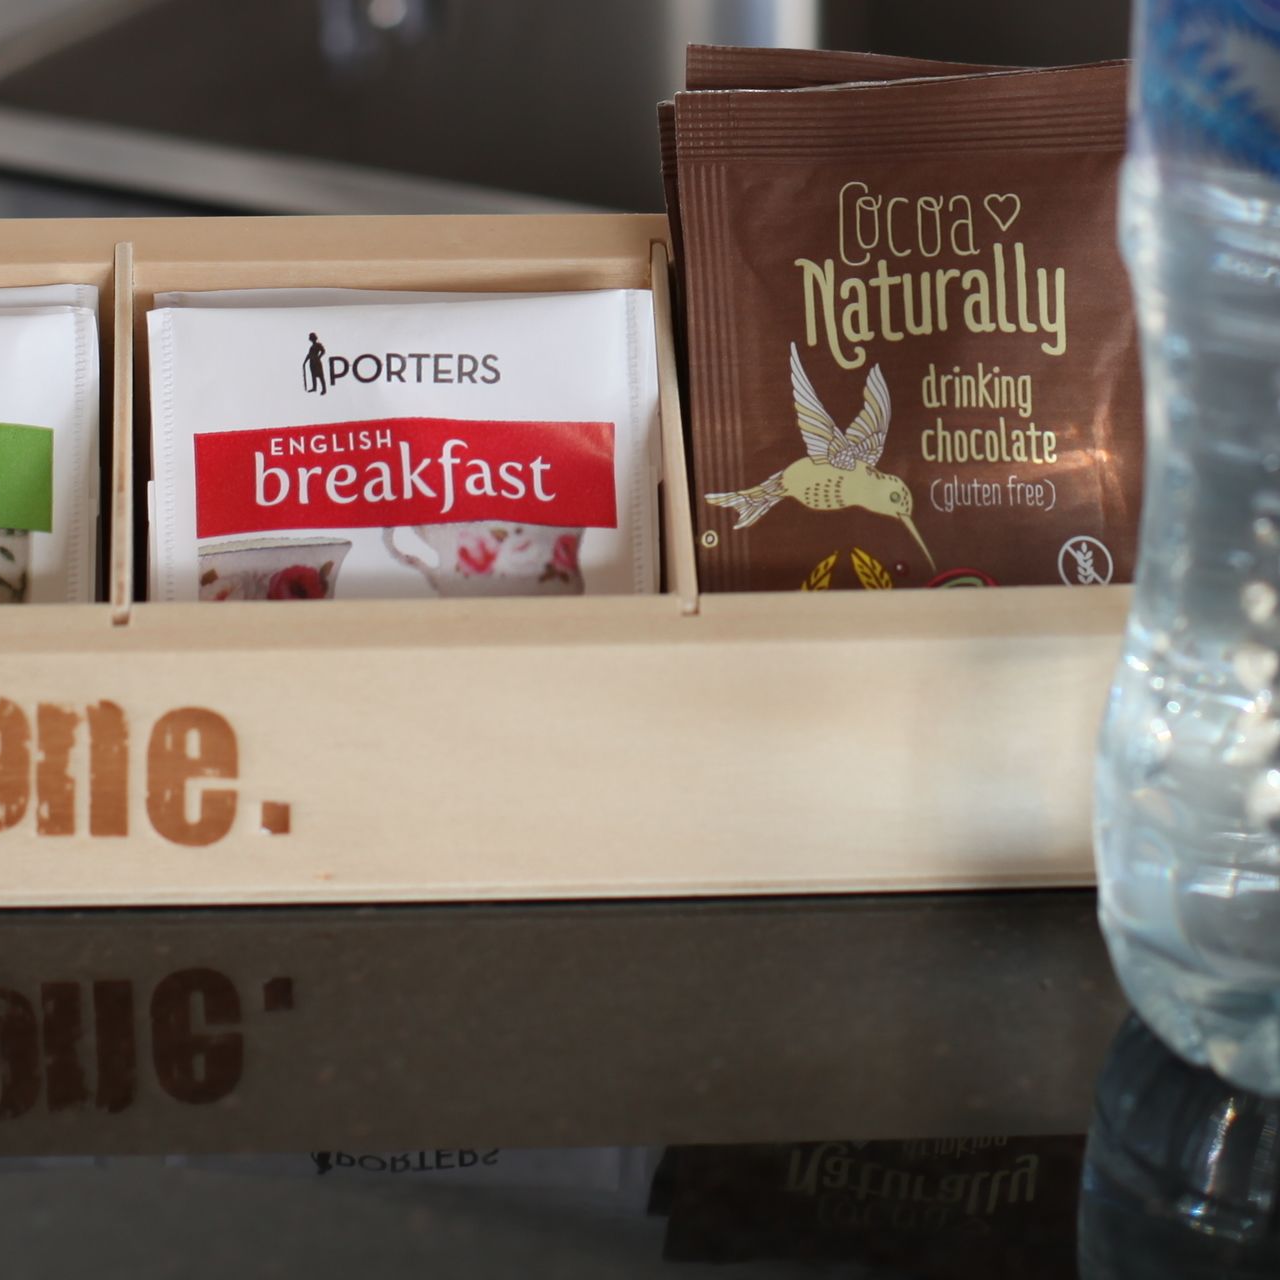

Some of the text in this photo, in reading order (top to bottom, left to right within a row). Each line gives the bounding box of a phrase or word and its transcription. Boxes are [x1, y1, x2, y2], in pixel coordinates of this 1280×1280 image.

[838, 181, 981, 266] Cocoa
[794, 242, 1068, 370] Naturally
[328, 352, 502, 387] PORTERS
[922, 363, 1033, 418] drinking
[270, 428, 393, 457] ENGLISH
[921, 417, 1058, 465] chocolate
[254, 438, 557, 514] breakfast
[929, 475, 1058, 512] (gluten free)
